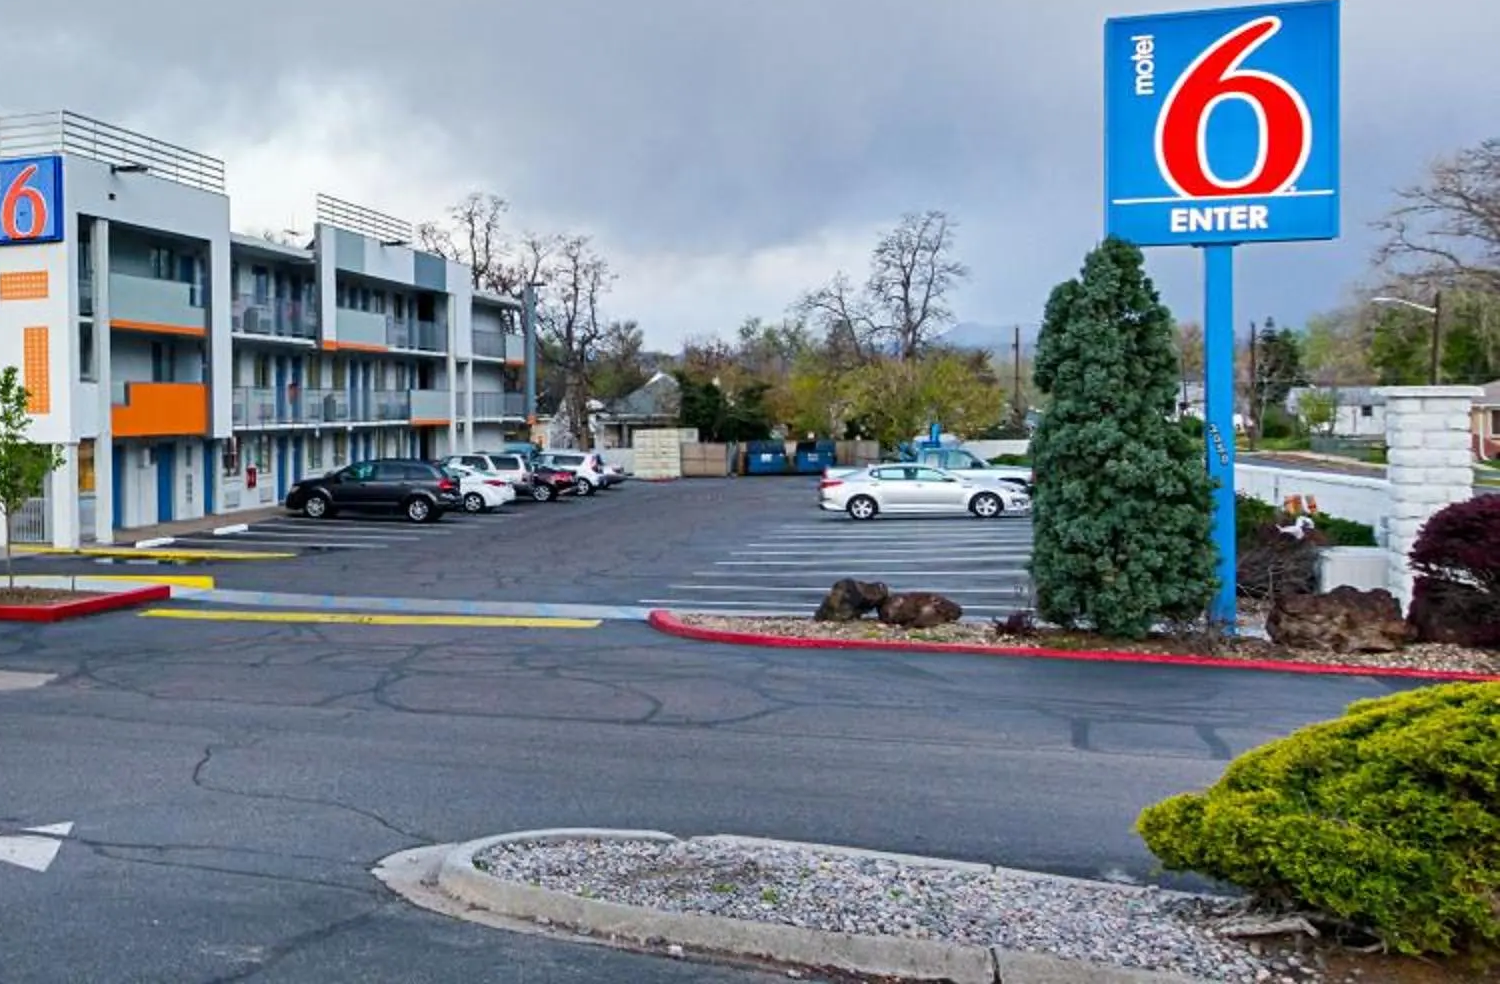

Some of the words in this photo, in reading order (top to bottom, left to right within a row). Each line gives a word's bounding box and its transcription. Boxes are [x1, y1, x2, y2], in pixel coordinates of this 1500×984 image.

[1130, 34, 1154, 95] motel
[1154, 16, 1312, 198] 6
[1, 163, 49, 240] 6
[1170, 205, 1269, 232] ENTER
